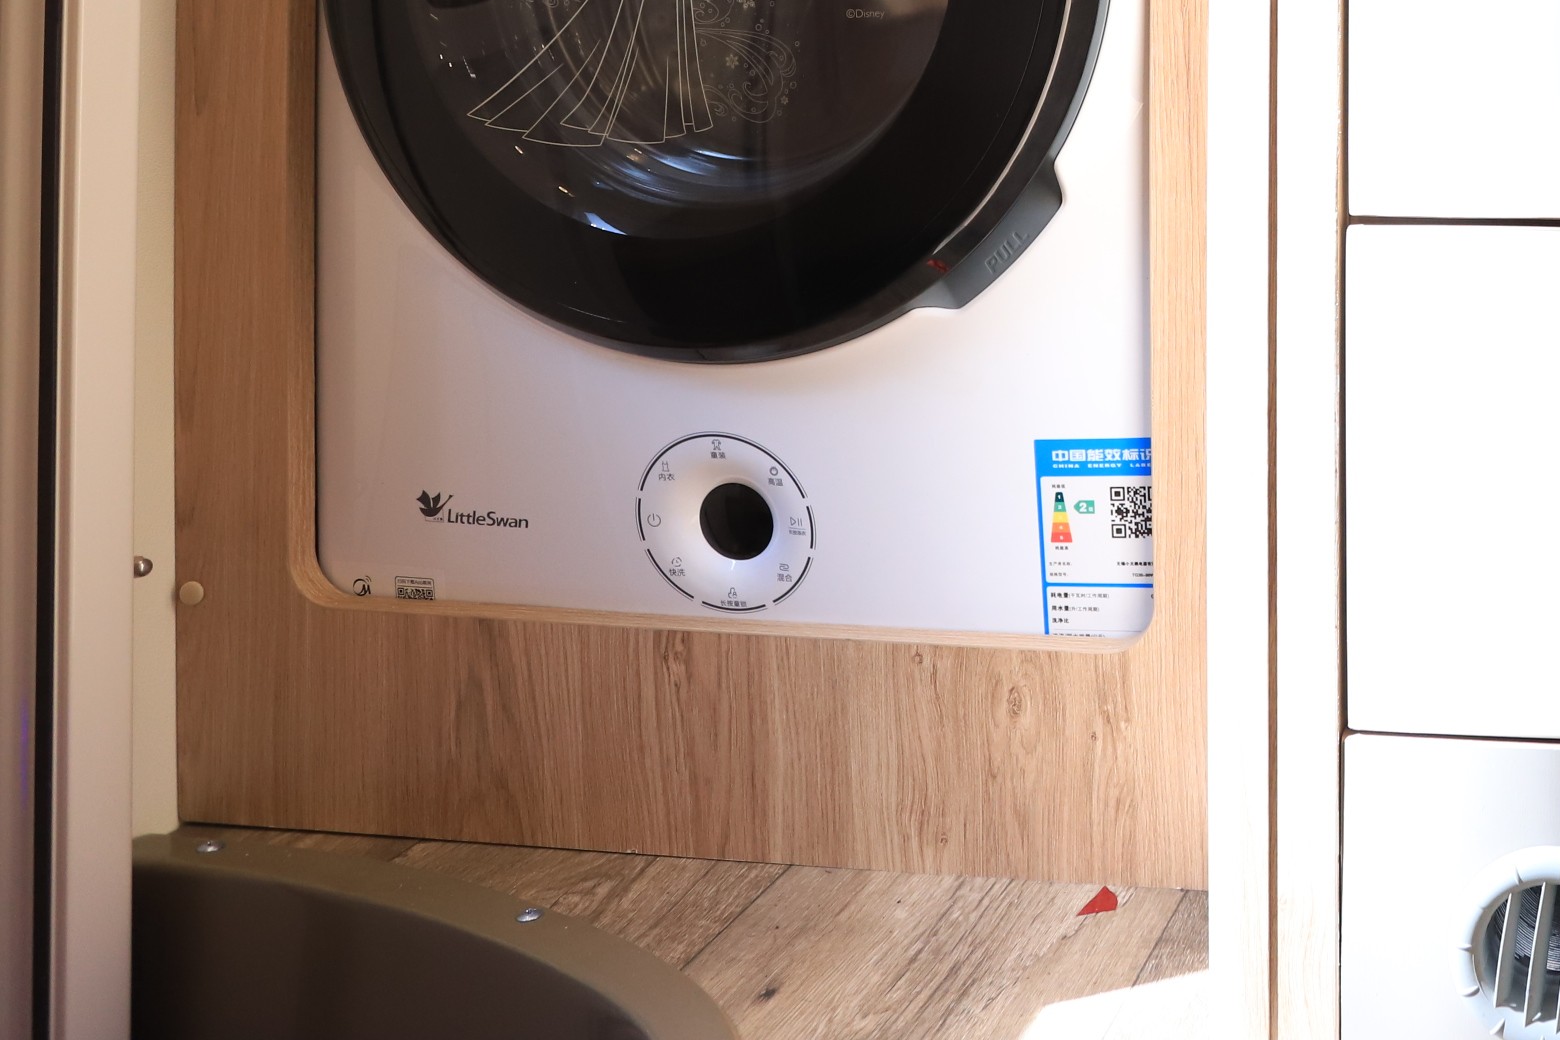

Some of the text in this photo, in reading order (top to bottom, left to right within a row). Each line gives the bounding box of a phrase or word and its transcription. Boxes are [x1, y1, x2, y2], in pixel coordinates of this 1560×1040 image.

[985, 231, 1030, 275] PULL
[658, 473, 675, 482] 内衣
[447, 508, 529, 529] LittleSwan
[669, 568, 686, 577] 快洗
